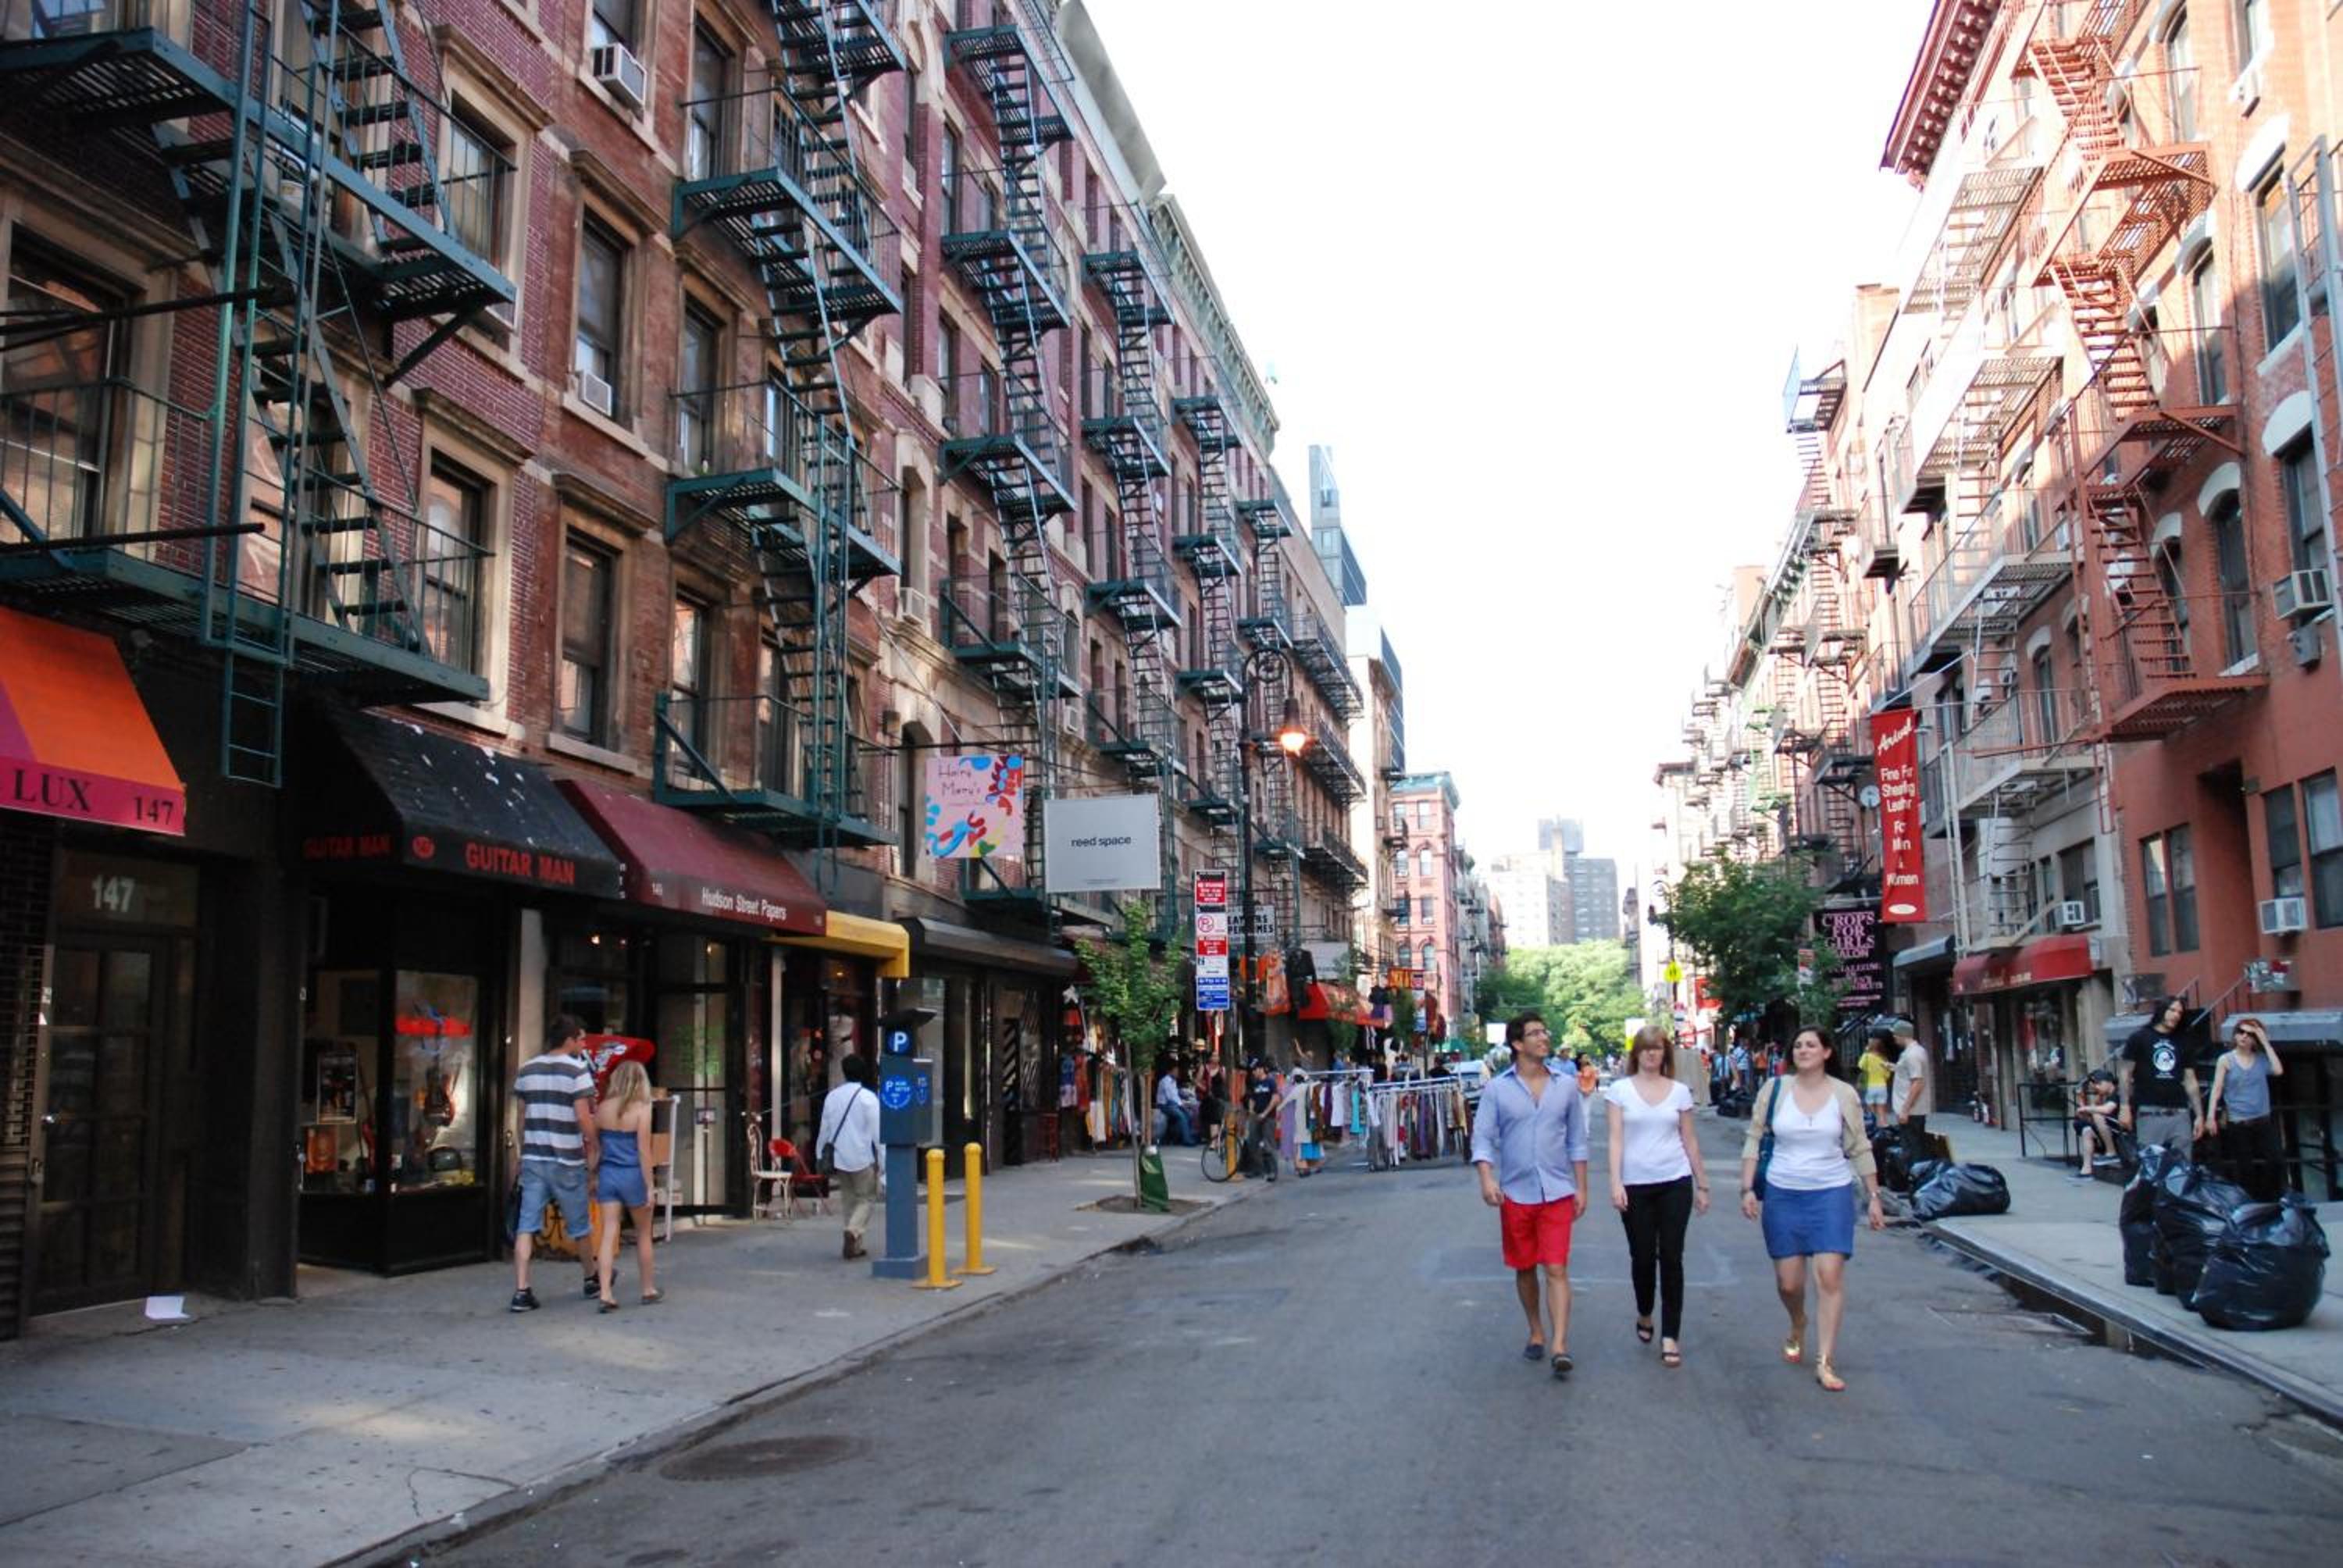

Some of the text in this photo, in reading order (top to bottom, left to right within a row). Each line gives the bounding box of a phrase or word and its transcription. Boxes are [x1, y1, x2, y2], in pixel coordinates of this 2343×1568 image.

[1881, 767, 1899, 781] Fine
[13, 768, 173, 825] LUX 147
[1071, 836, 1132, 848] reed space
[465, 842, 532, 876] GUITAR
[539, 856, 576, 886] MAN
[91, 874, 135, 913] 147
[702, 886, 733, 911] Hudson
[761, 899, 786, 923] Papers
[1822, 912, 1874, 927] CROPS
[1832, 925, 1866, 938] FOR
[1824, 935, 1874, 950] GIRLS
[1838, 949, 1869, 959] ALON
[893, 1031, 908, 1052] P
